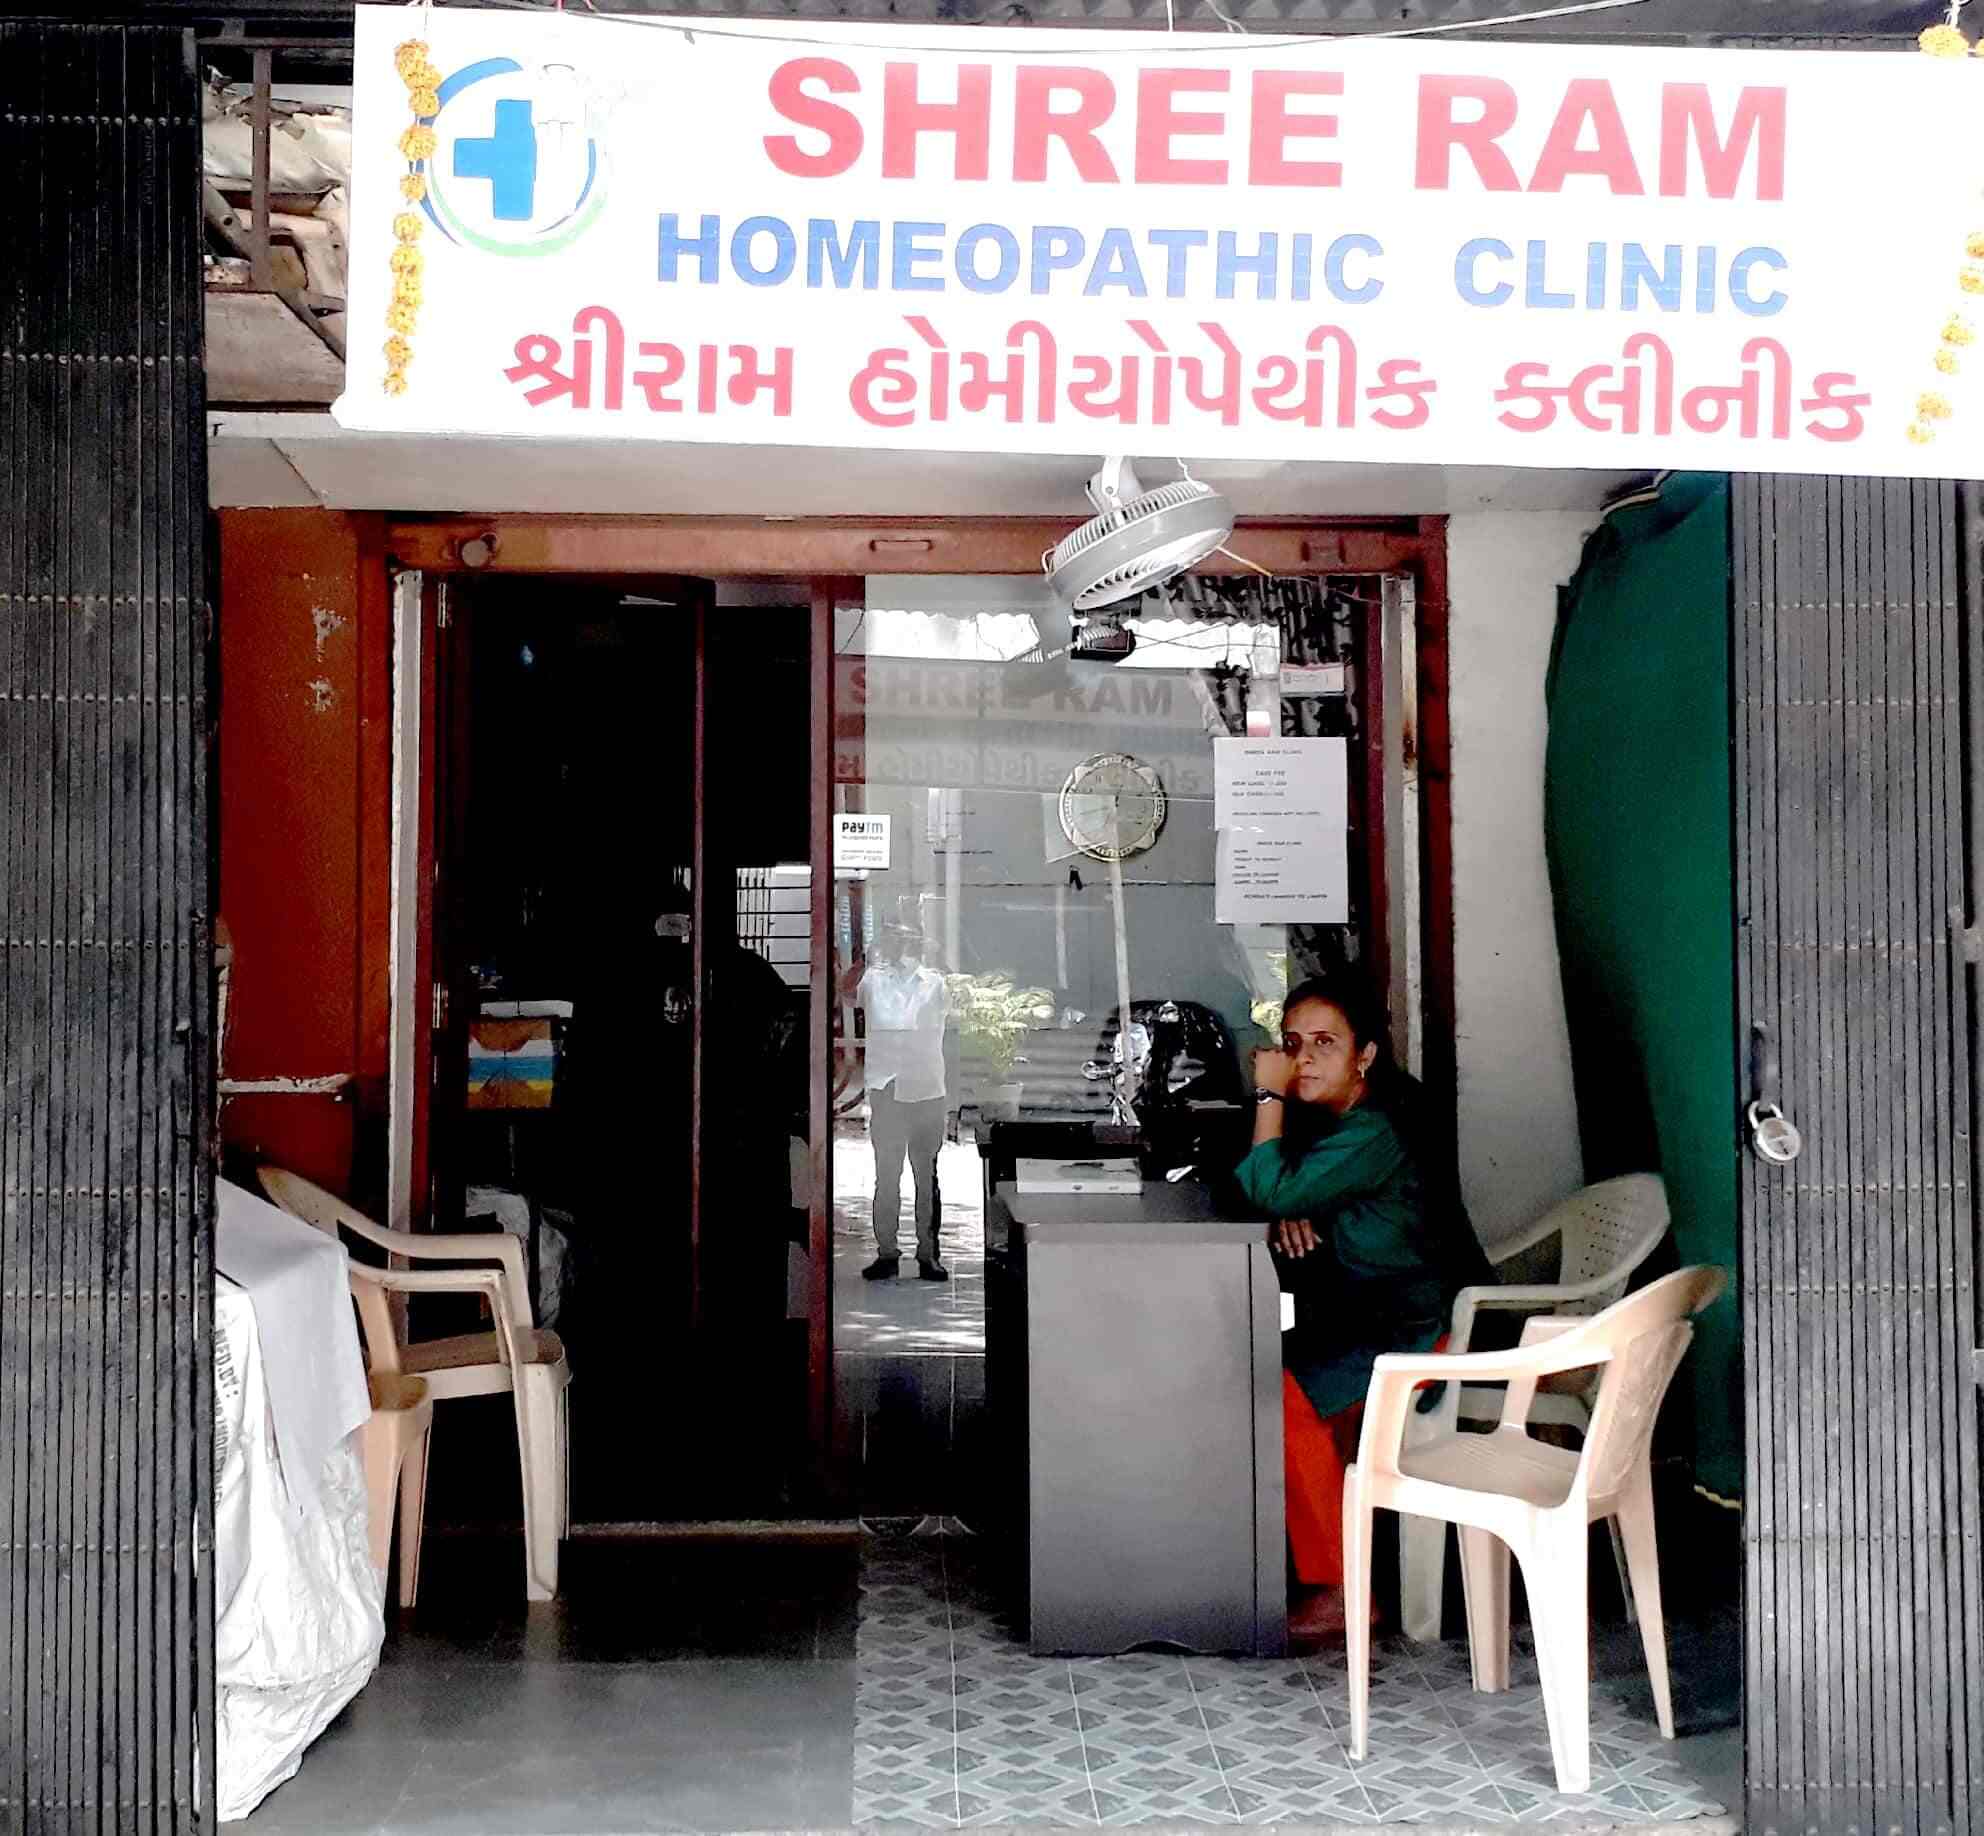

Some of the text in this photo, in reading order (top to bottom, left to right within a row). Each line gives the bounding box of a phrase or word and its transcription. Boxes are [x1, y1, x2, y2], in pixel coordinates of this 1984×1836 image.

[763, 57, 1785, 200] SHREE RAM
[658, 213, 1787, 316] HOMEOPATHIC CLINIC
[505, 305, 794, 417] શ્રીરામ
[850, 315, 1437, 429] હોમીયોપેથીક
